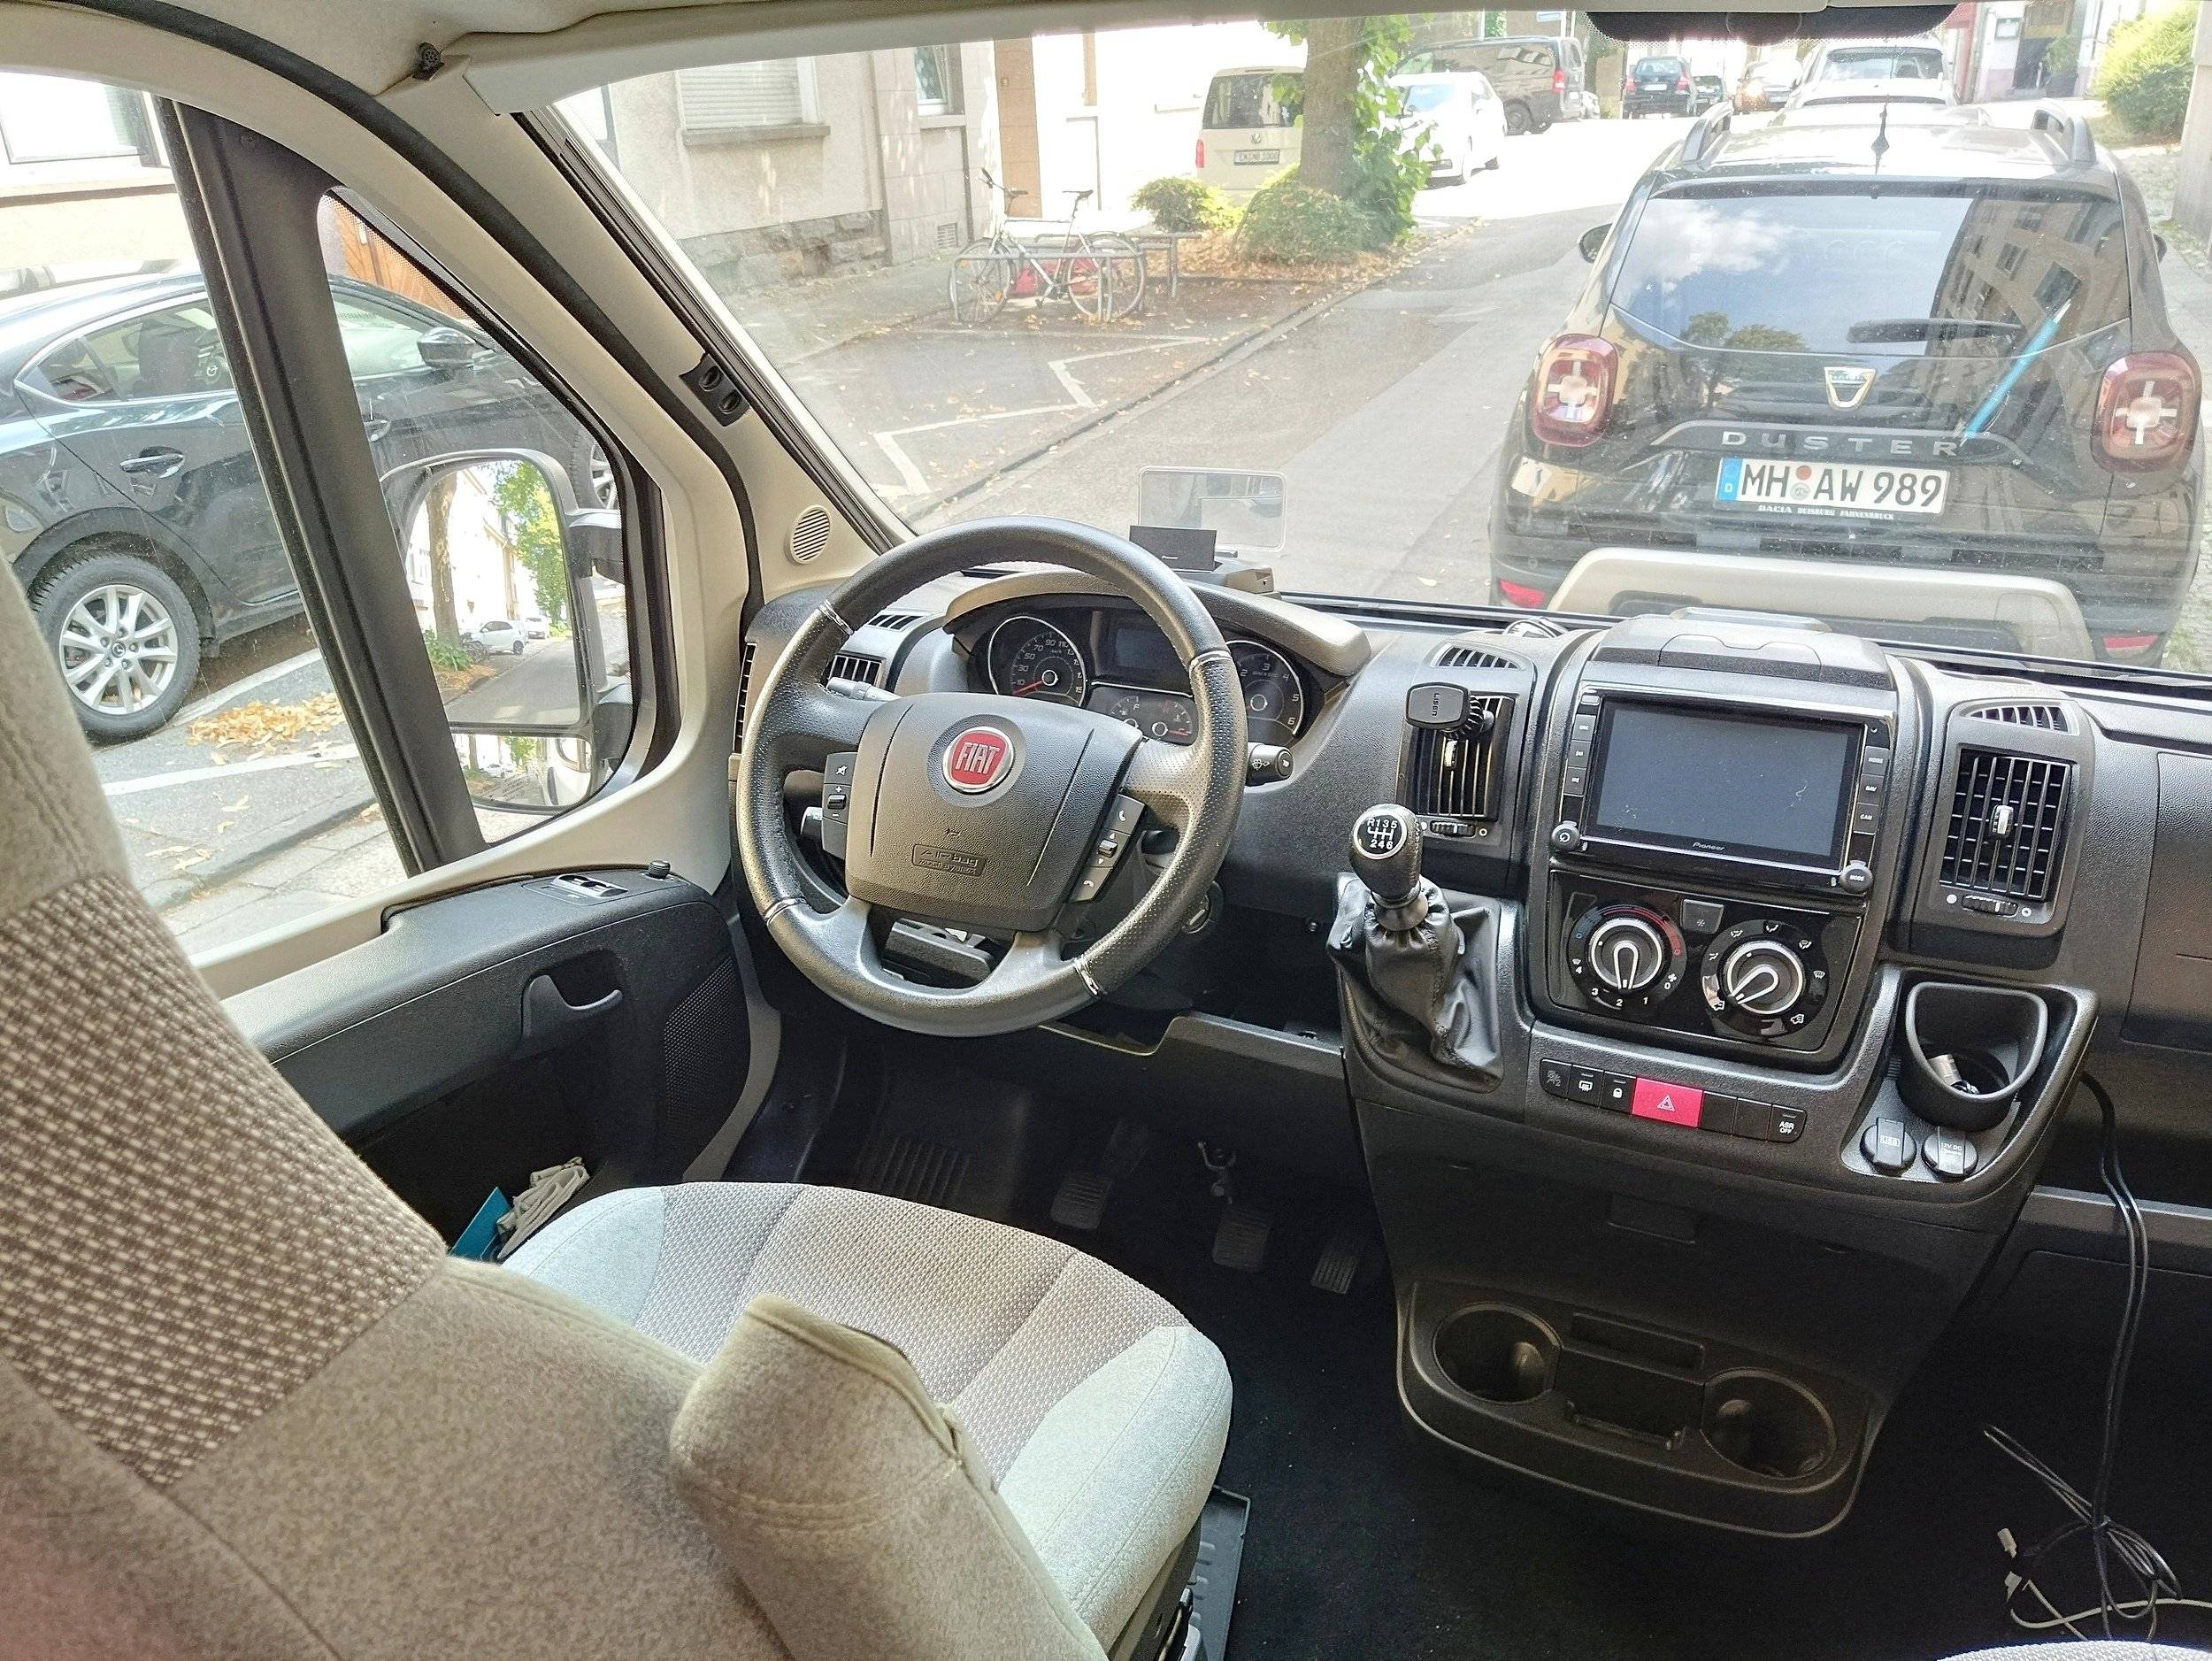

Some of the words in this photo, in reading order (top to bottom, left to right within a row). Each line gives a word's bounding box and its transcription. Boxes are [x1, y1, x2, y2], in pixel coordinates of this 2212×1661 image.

[1721, 431, 1958, 457] DUSTER
[1724, 482, 1733, 493] D
[1741, 465, 1790, 497] MH
[1814, 469, 1863, 502] AW
[1873, 471, 1942, 507] 989
[1758, 504, 1792, 514] DACIA
[956, 742, 1001, 774] FIAT
[1367, 818, 1375, 827] R
[1382, 819, 1389, 828] 3
[1390, 820, 1398, 829] 5
[1370, 839, 1378, 849] 2
[1378, 840, 1385, 849] 4
[1386, 841, 1394, 850] 6
[1693, 842, 1724, 851] Pioneer
